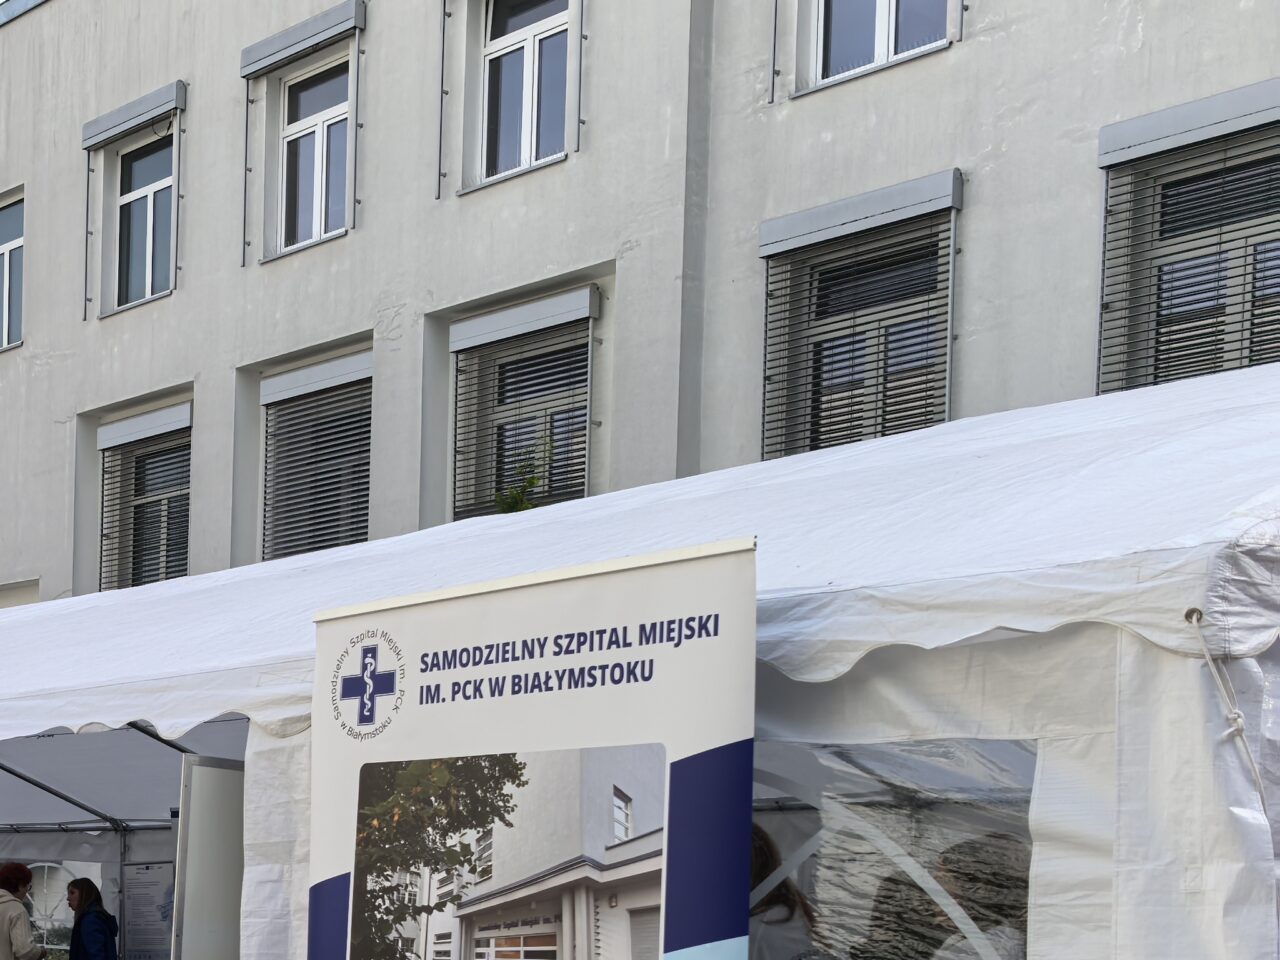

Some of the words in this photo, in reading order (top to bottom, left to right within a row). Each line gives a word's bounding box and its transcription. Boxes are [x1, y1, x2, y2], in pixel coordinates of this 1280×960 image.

[419, 636, 549, 673] SAMODZIELNY
[552, 625, 632, 657] SZPITAL
[638, 613, 720, 648] MIEJSKI
[330, 647, 350, 721] Samodzielny
[349, 628, 379, 648] Szpital
[380, 630, 402, 662] Miejski
[392, 689, 406, 715] PCK
[419, 684, 446, 705] IM.
[451, 678, 484, 702] PCK
[488, 676, 507, 697] W
[511, 659, 654, 695] BIAŁYMSTOKU
[346, 716, 393, 742] Białymstoku
